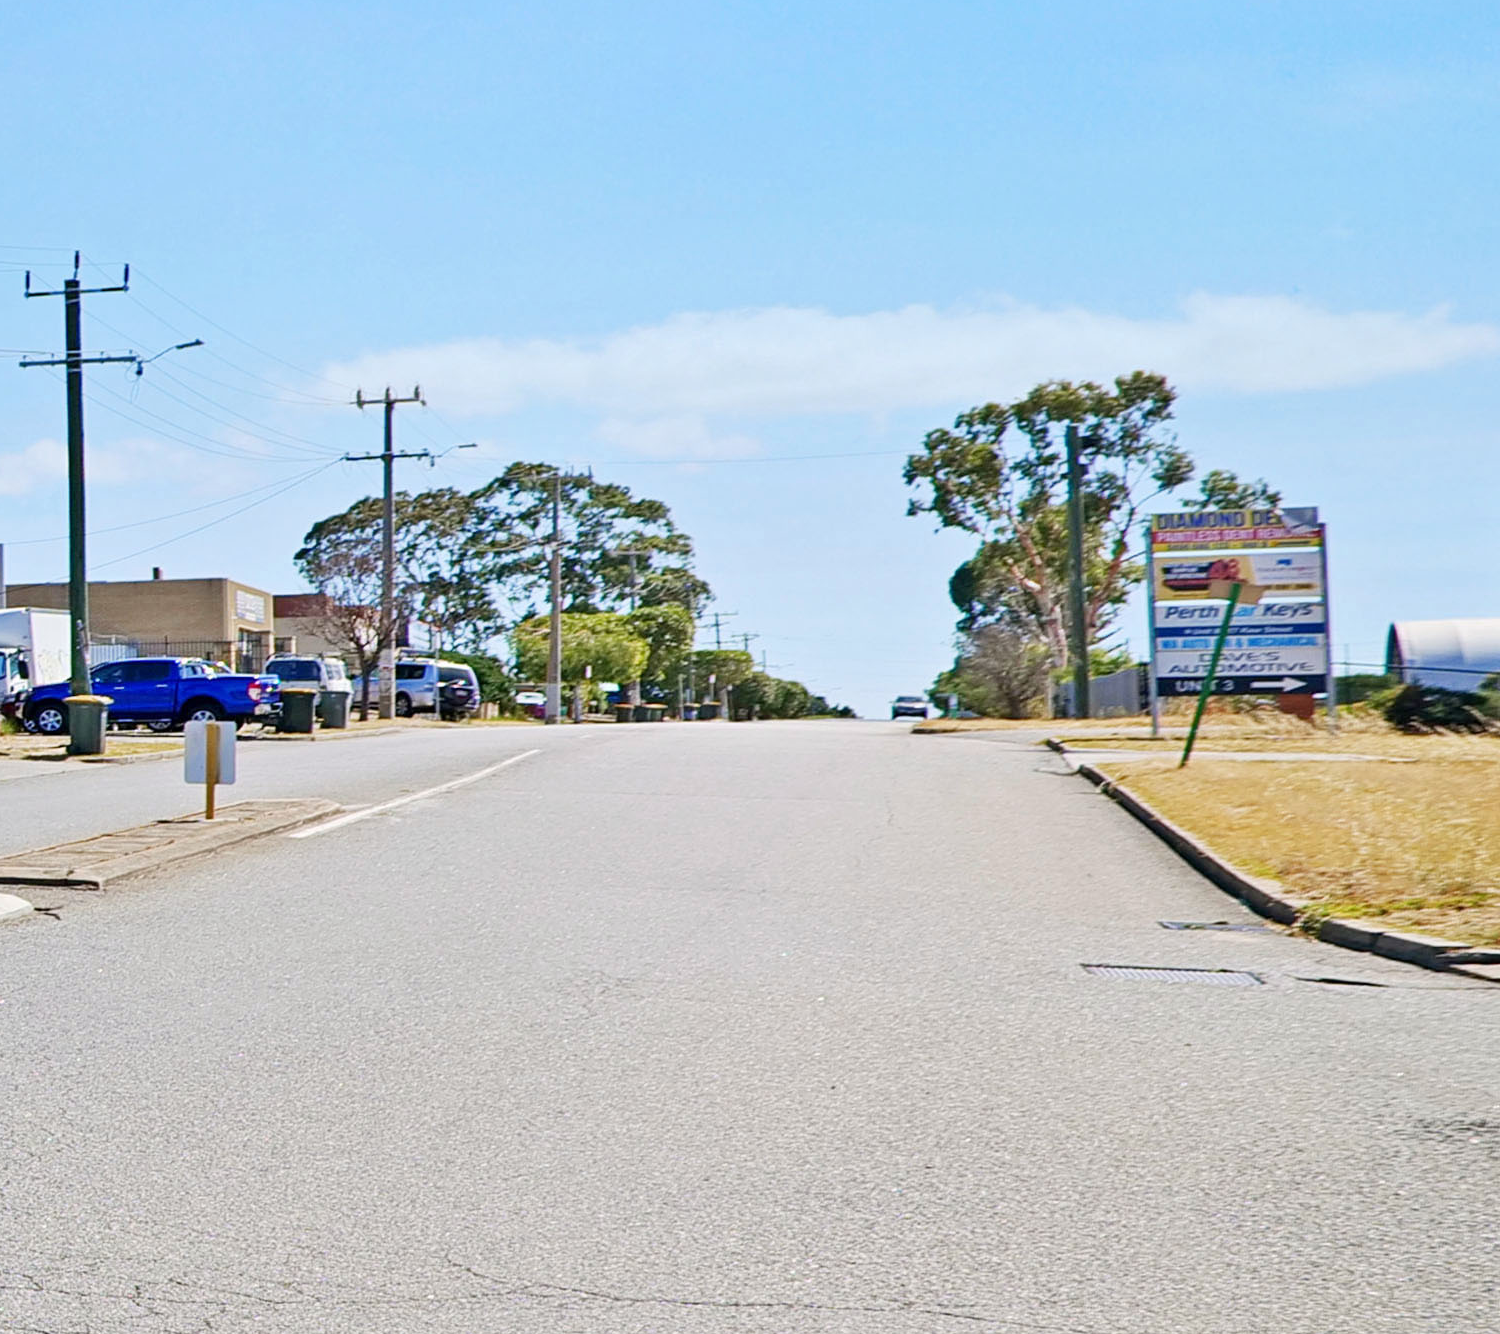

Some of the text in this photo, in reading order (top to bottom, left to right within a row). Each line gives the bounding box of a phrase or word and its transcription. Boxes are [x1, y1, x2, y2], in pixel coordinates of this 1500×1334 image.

[1158, 510, 1283, 529] DIAMOND DE
[1222, 529, 1254, 541] DENT
[1165, 606, 1219, 619] Perth
[1263, 603, 1314, 618] Keys
[1168, 662, 1316, 674] AUTOMOTIVE
[1175, 680, 1235, 692] UNT 3
